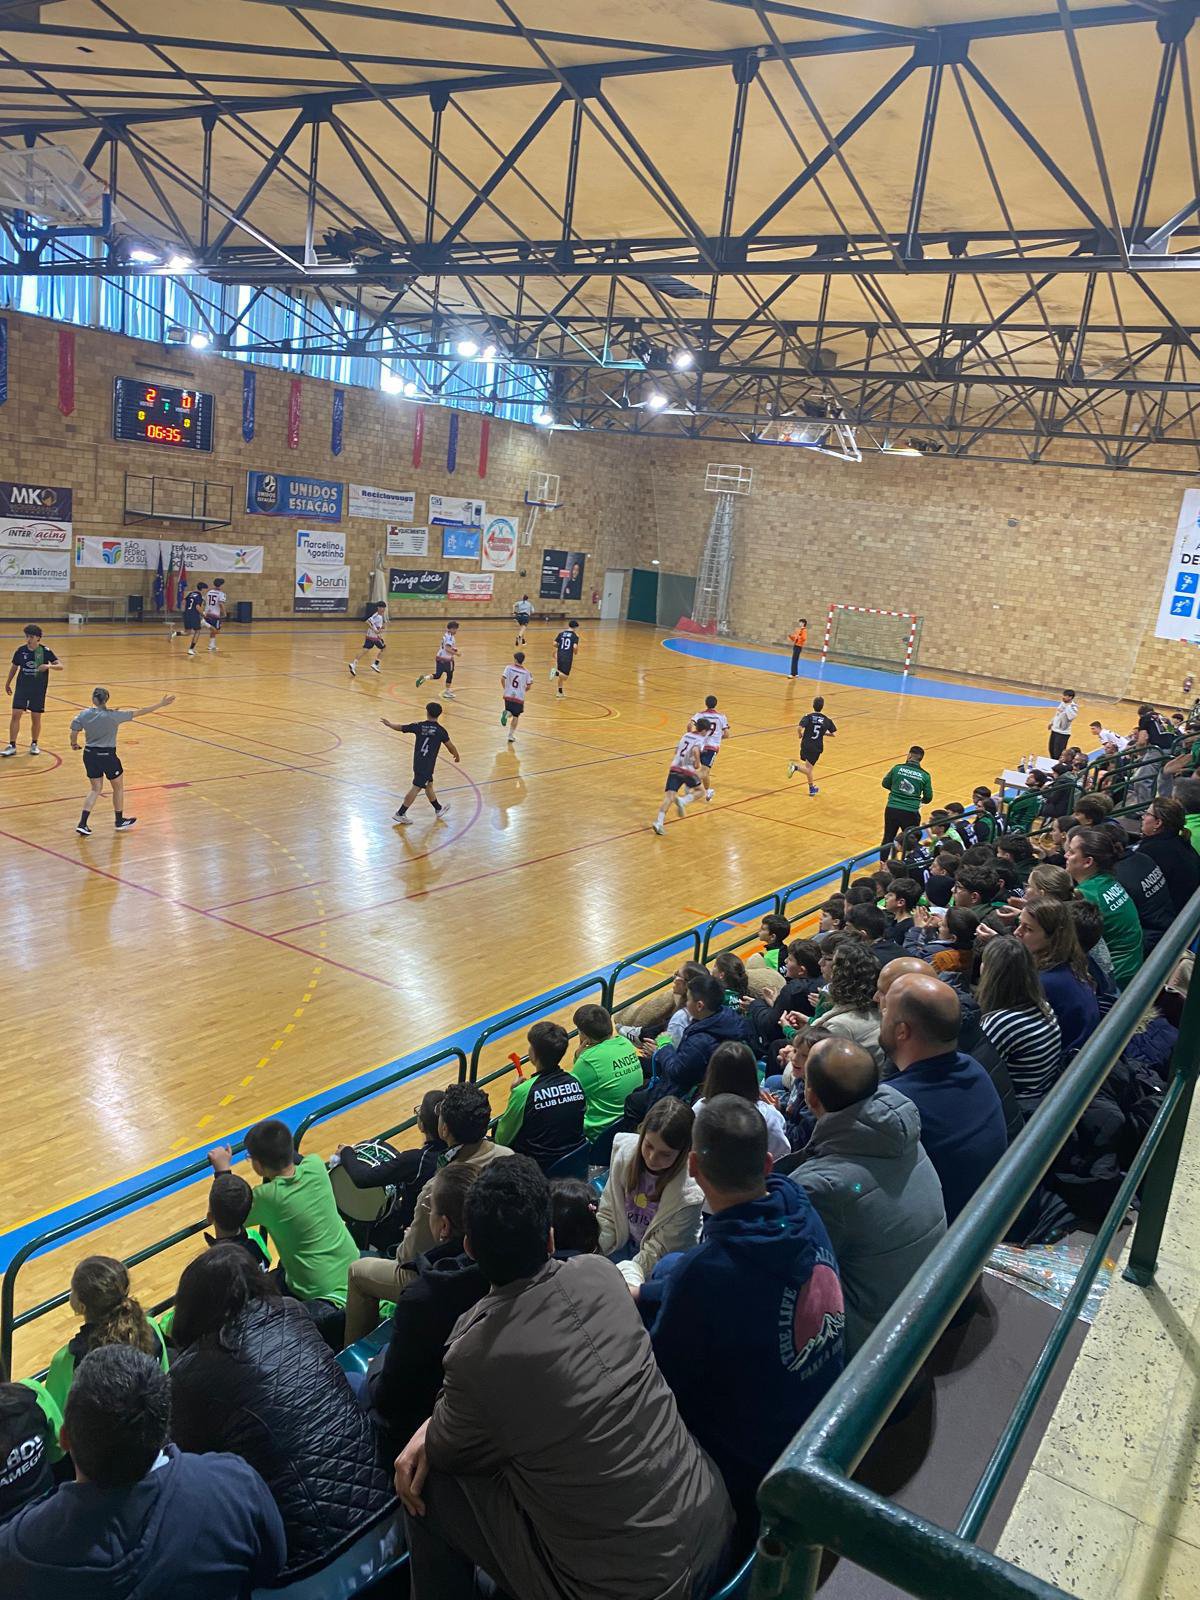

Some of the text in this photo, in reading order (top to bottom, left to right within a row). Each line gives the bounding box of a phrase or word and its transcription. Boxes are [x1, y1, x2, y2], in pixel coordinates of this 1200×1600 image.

[145, 388, 157, 402] 2
[146, 424, 181, 442] 06:35
[289, 481, 338, 500] UNIDOS
[289, 497, 337, 514] ESTAÇÃO
[8, 529, 33, 538] INTER
[124, 541, 139, 550] SÃO
[303, 540, 340, 550] Marcelino
[124, 549, 147, 557] PEDRO
[186, 553, 209, 562] PEDRO
[307, 549, 344, 558] Agostinho
[136, 556, 148, 564] SUL
[1181, 554, 1200, 565] DE
[20, 567, 68, 577] ambiformed
[315, 575, 347, 587] Beruni
[392, 571, 442, 592] pingo doce
[187, 600, 194, 610] 3
[208, 595, 217, 606] 15
[560, 637, 571, 650] 19
[511, 675, 519, 689] 6
[810, 724, 821, 740] 5
[420, 736, 430, 757] 4
[680, 740, 690, 757] 2
[899, 767, 923, 778] ANDEBOL
[612, 1052, 640, 1071] ANDEB
[614, 1067, 632, 1078] CLUB
[533, 1081, 583, 1102] ANDEBOL
[534, 1094, 584, 1110] CLUB LAMEGO
[778, 1286, 798, 1327] LIFE
